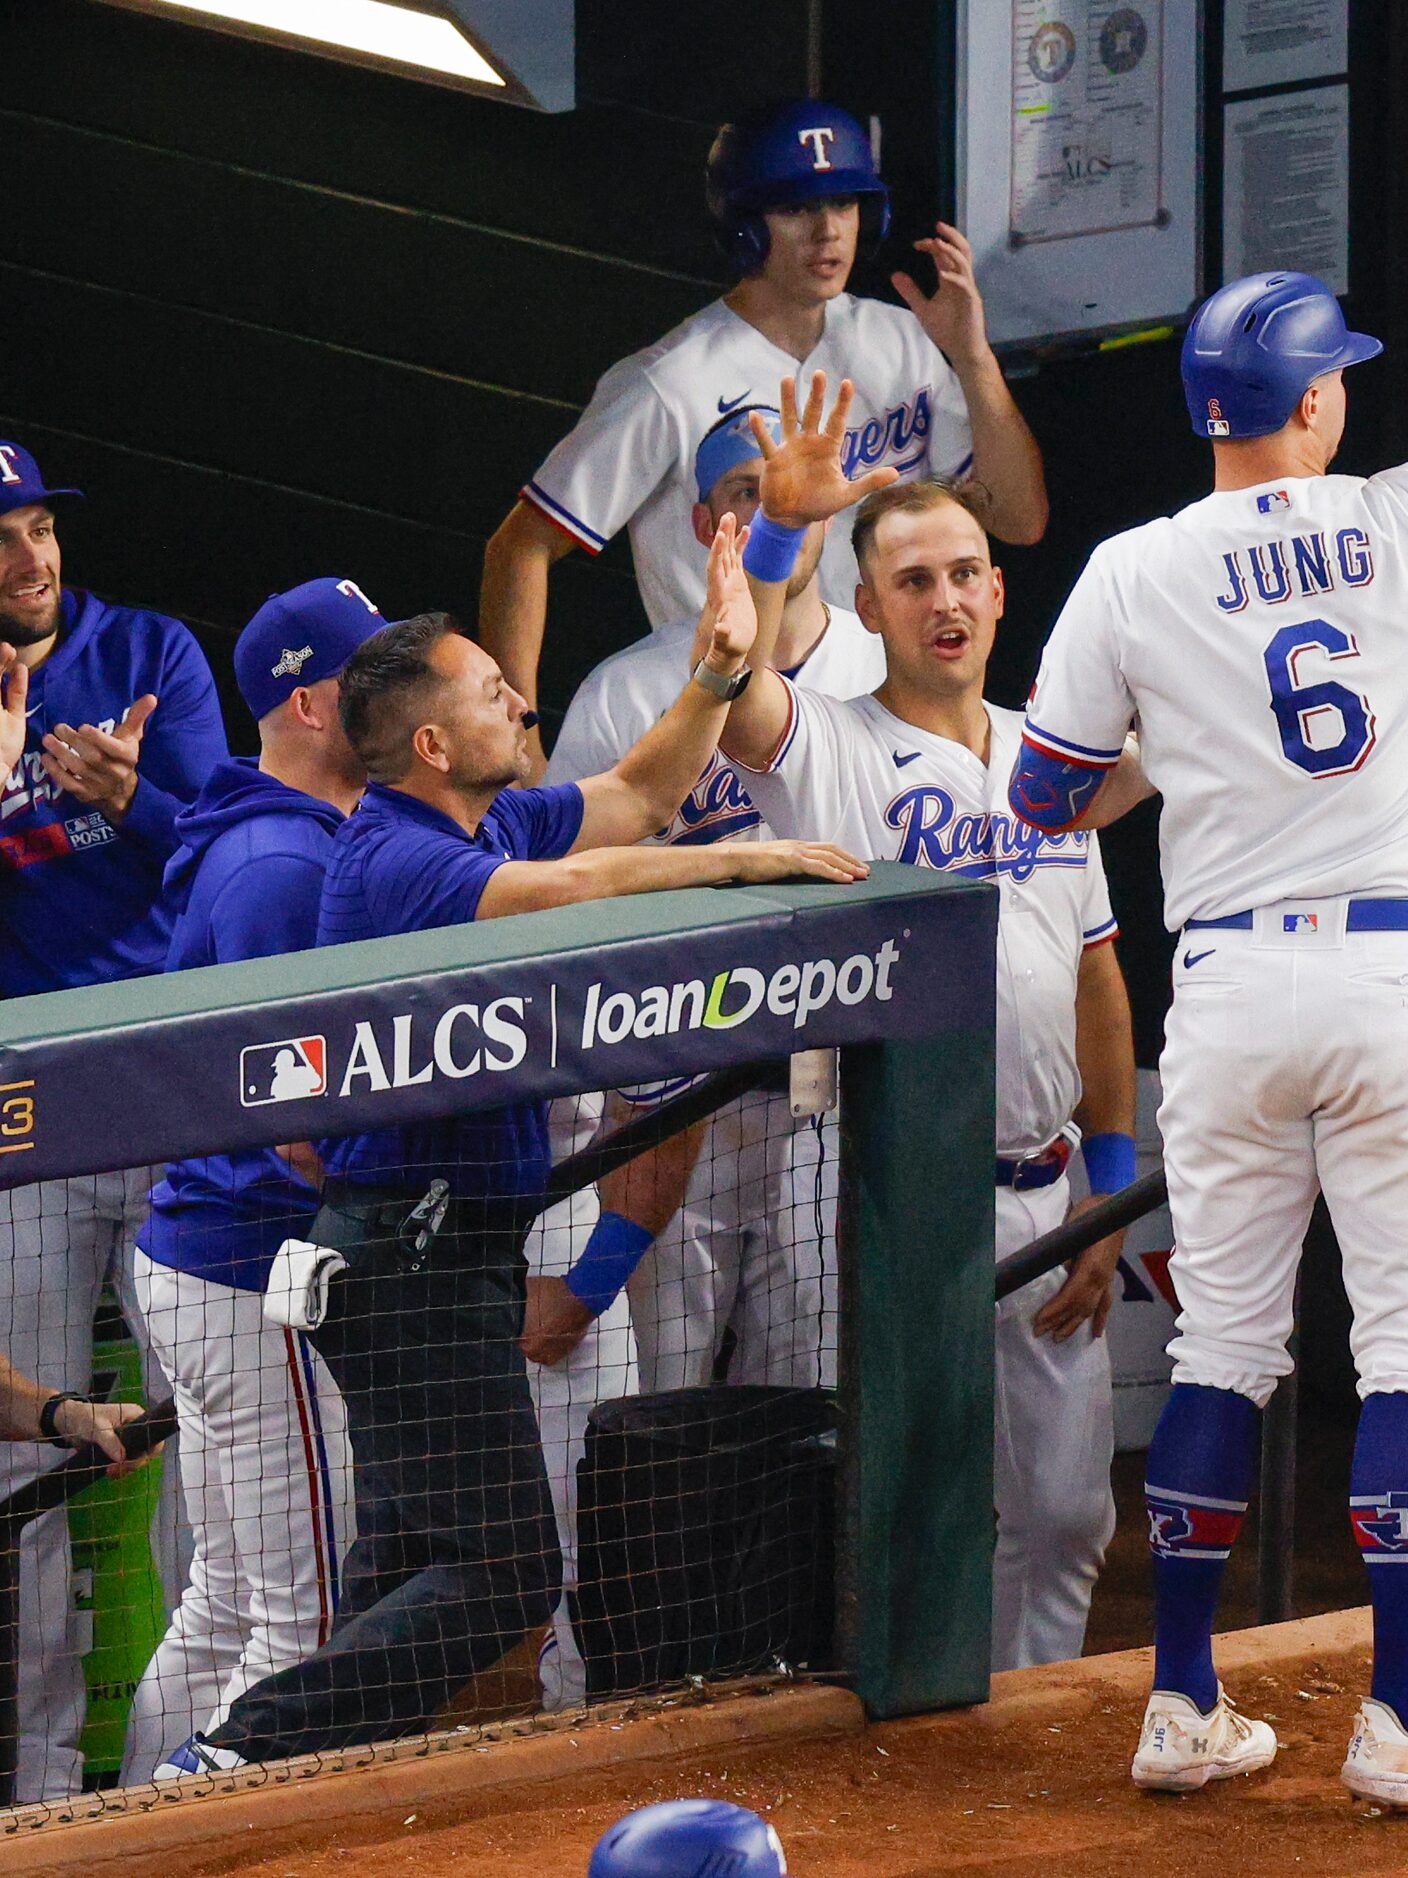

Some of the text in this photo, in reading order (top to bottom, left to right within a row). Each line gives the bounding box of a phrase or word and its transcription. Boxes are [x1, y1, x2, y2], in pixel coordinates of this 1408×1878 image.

[798, 127, 836, 172] T
[840, 385, 934, 480] gers
[1208, 398, 1222, 420] 6
[1216, 527, 1375, 614] JUNG
[1260, 618, 1377, 780] 6
[338, 938, 900, 1098] ALCS loanDepot
[1, 1097, 34, 1136] 3
